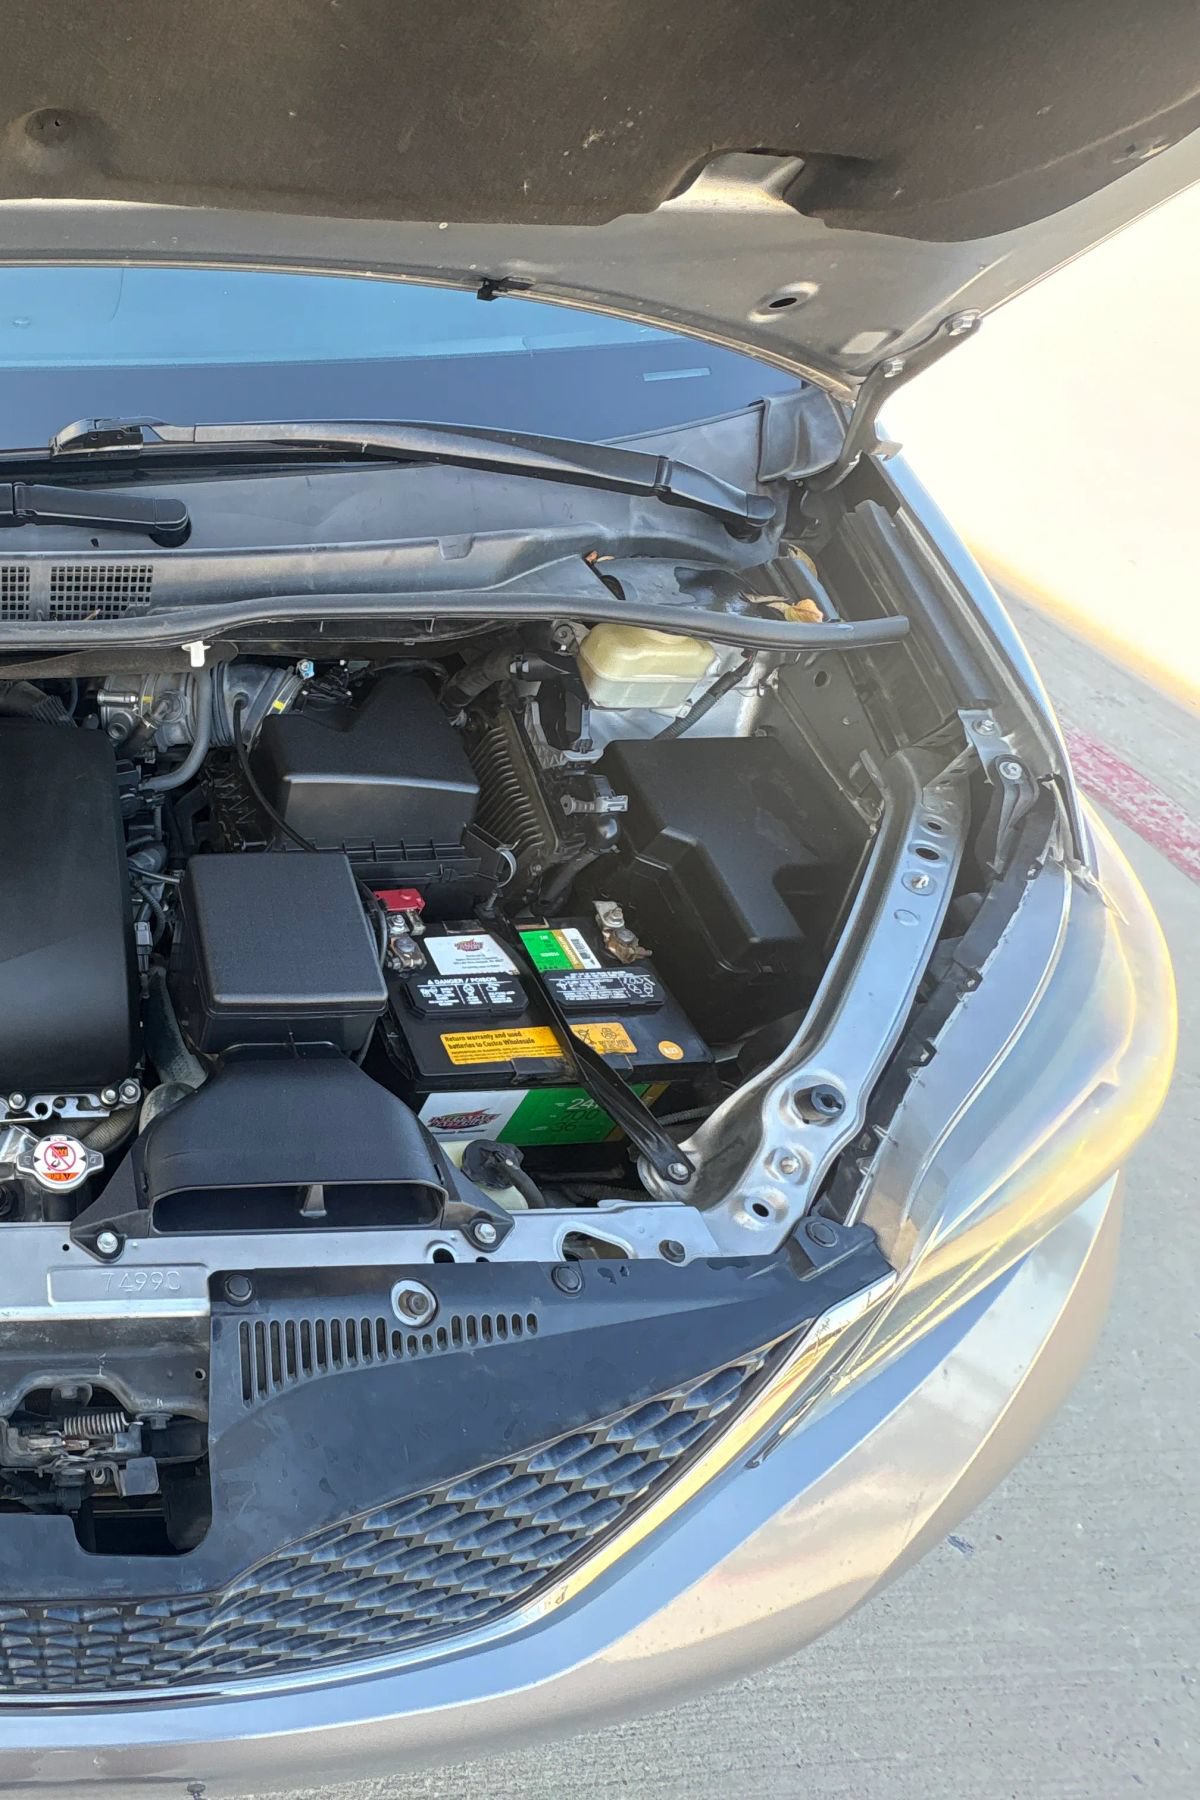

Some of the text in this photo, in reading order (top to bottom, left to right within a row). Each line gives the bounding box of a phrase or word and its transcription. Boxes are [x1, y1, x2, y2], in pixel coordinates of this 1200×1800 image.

[448, 1042, 475, 1050] batteries
[483, 1040, 504, 1048] Costco
[567, 1098, 599, 1110] 24
